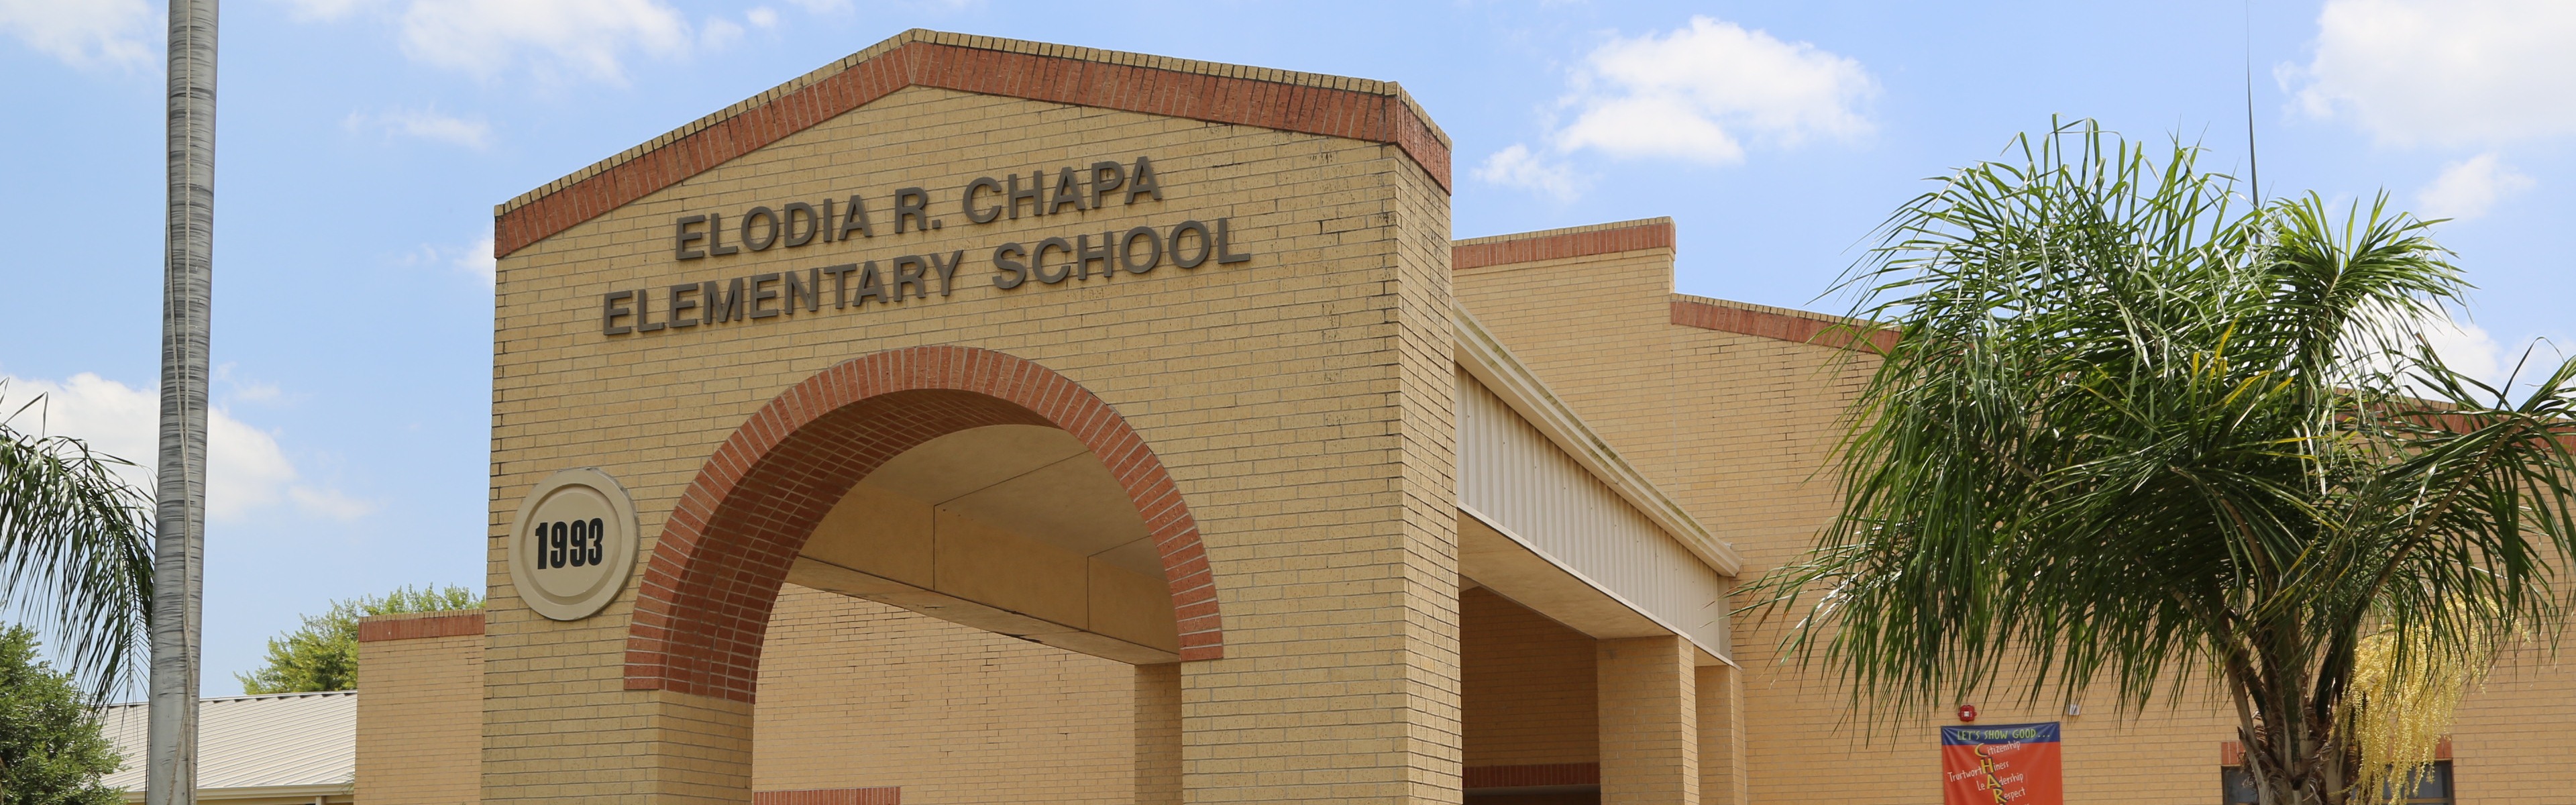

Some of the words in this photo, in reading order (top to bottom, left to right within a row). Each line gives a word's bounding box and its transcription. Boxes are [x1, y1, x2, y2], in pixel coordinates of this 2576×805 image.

[676, 195, 873, 260] ELODIA
[895, 186, 941, 233] R.
[963, 156, 1163, 223] CHAPA
[602, 250, 963, 335] ELEMENTARY
[992, 217, 1250, 289] SCHOOL
[535, 517, 604, 570] 1993
[1957, 730, 1980, 741] LET'S
[1984, 730, 2008, 739] SHOW
